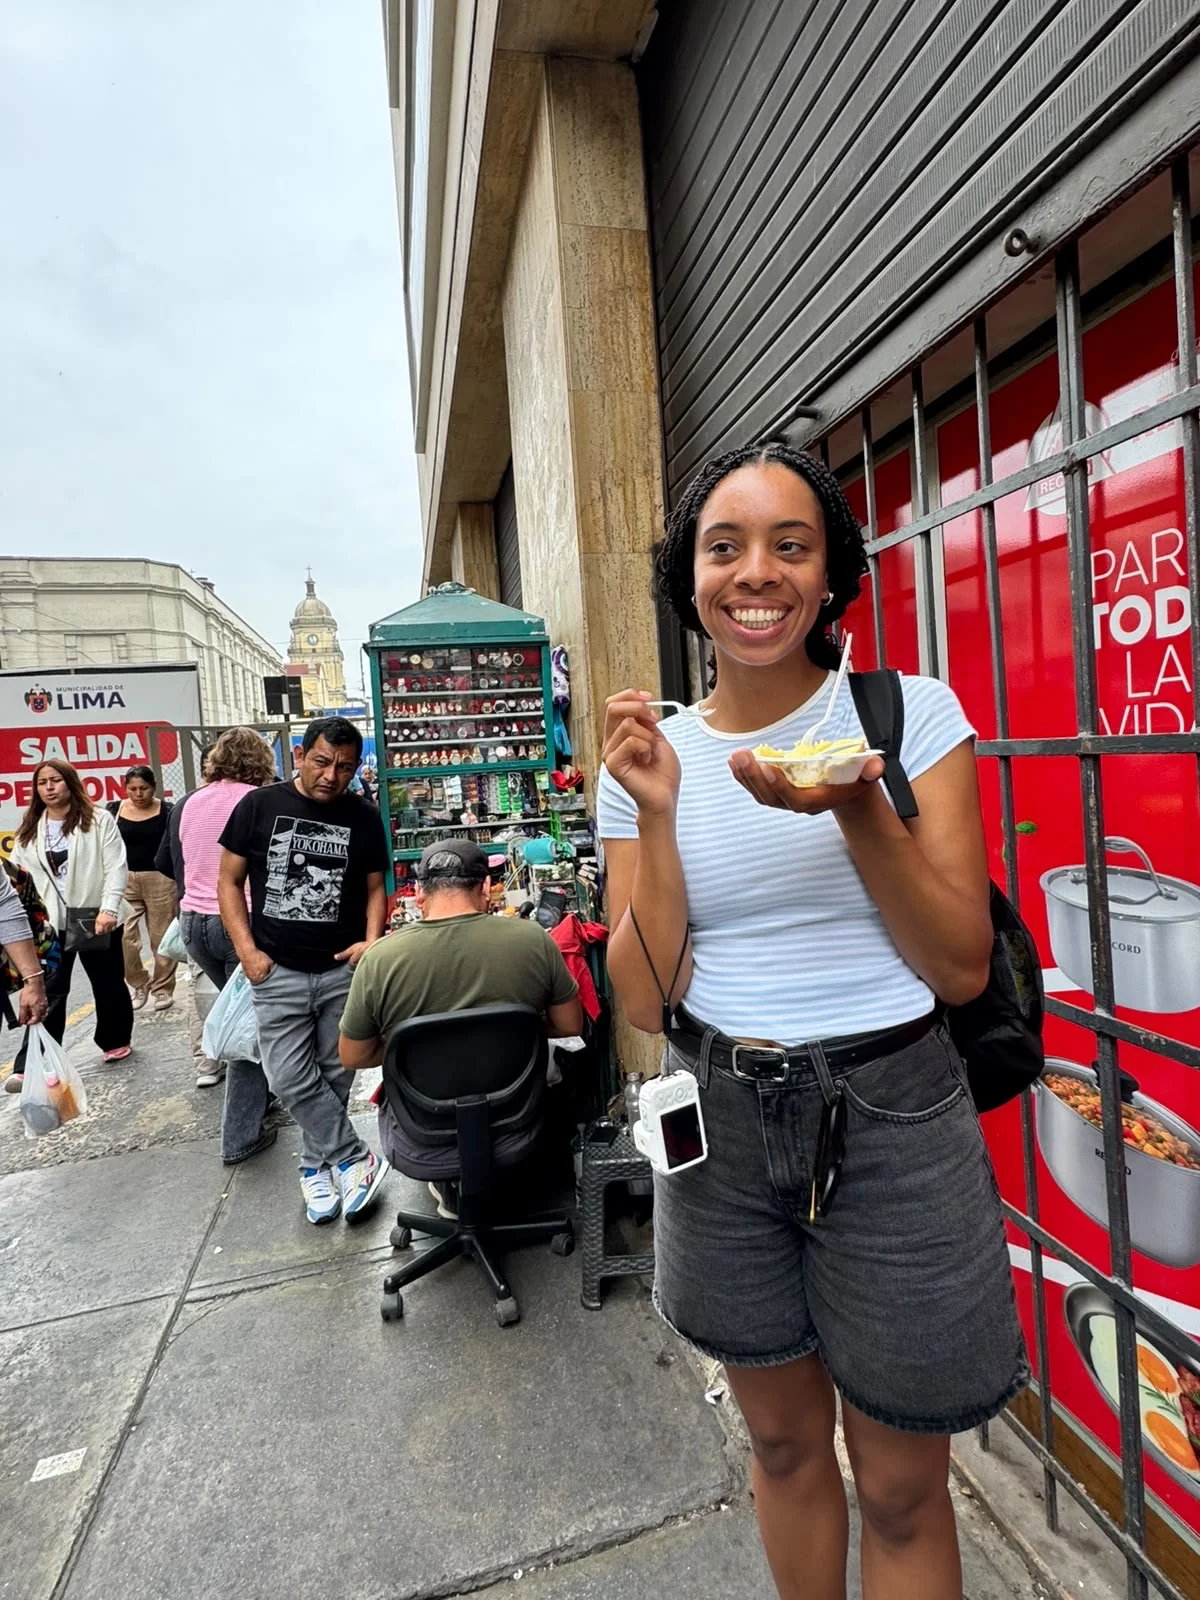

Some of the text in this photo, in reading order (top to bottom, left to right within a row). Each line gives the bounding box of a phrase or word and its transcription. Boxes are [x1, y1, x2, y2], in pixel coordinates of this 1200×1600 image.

[1090, 528, 1186, 598] PAR
[1092, 585, 1192, 650] TOD
[1126, 644, 1192, 698] LA
[57, 691, 126, 710] LIMA
[1099, 702, 1195, 735] VID
[19, 733, 146, 766] SALIDA
[293, 835, 348, 857] YOKOHAMA
[1112, 941, 1141, 954] CORD
